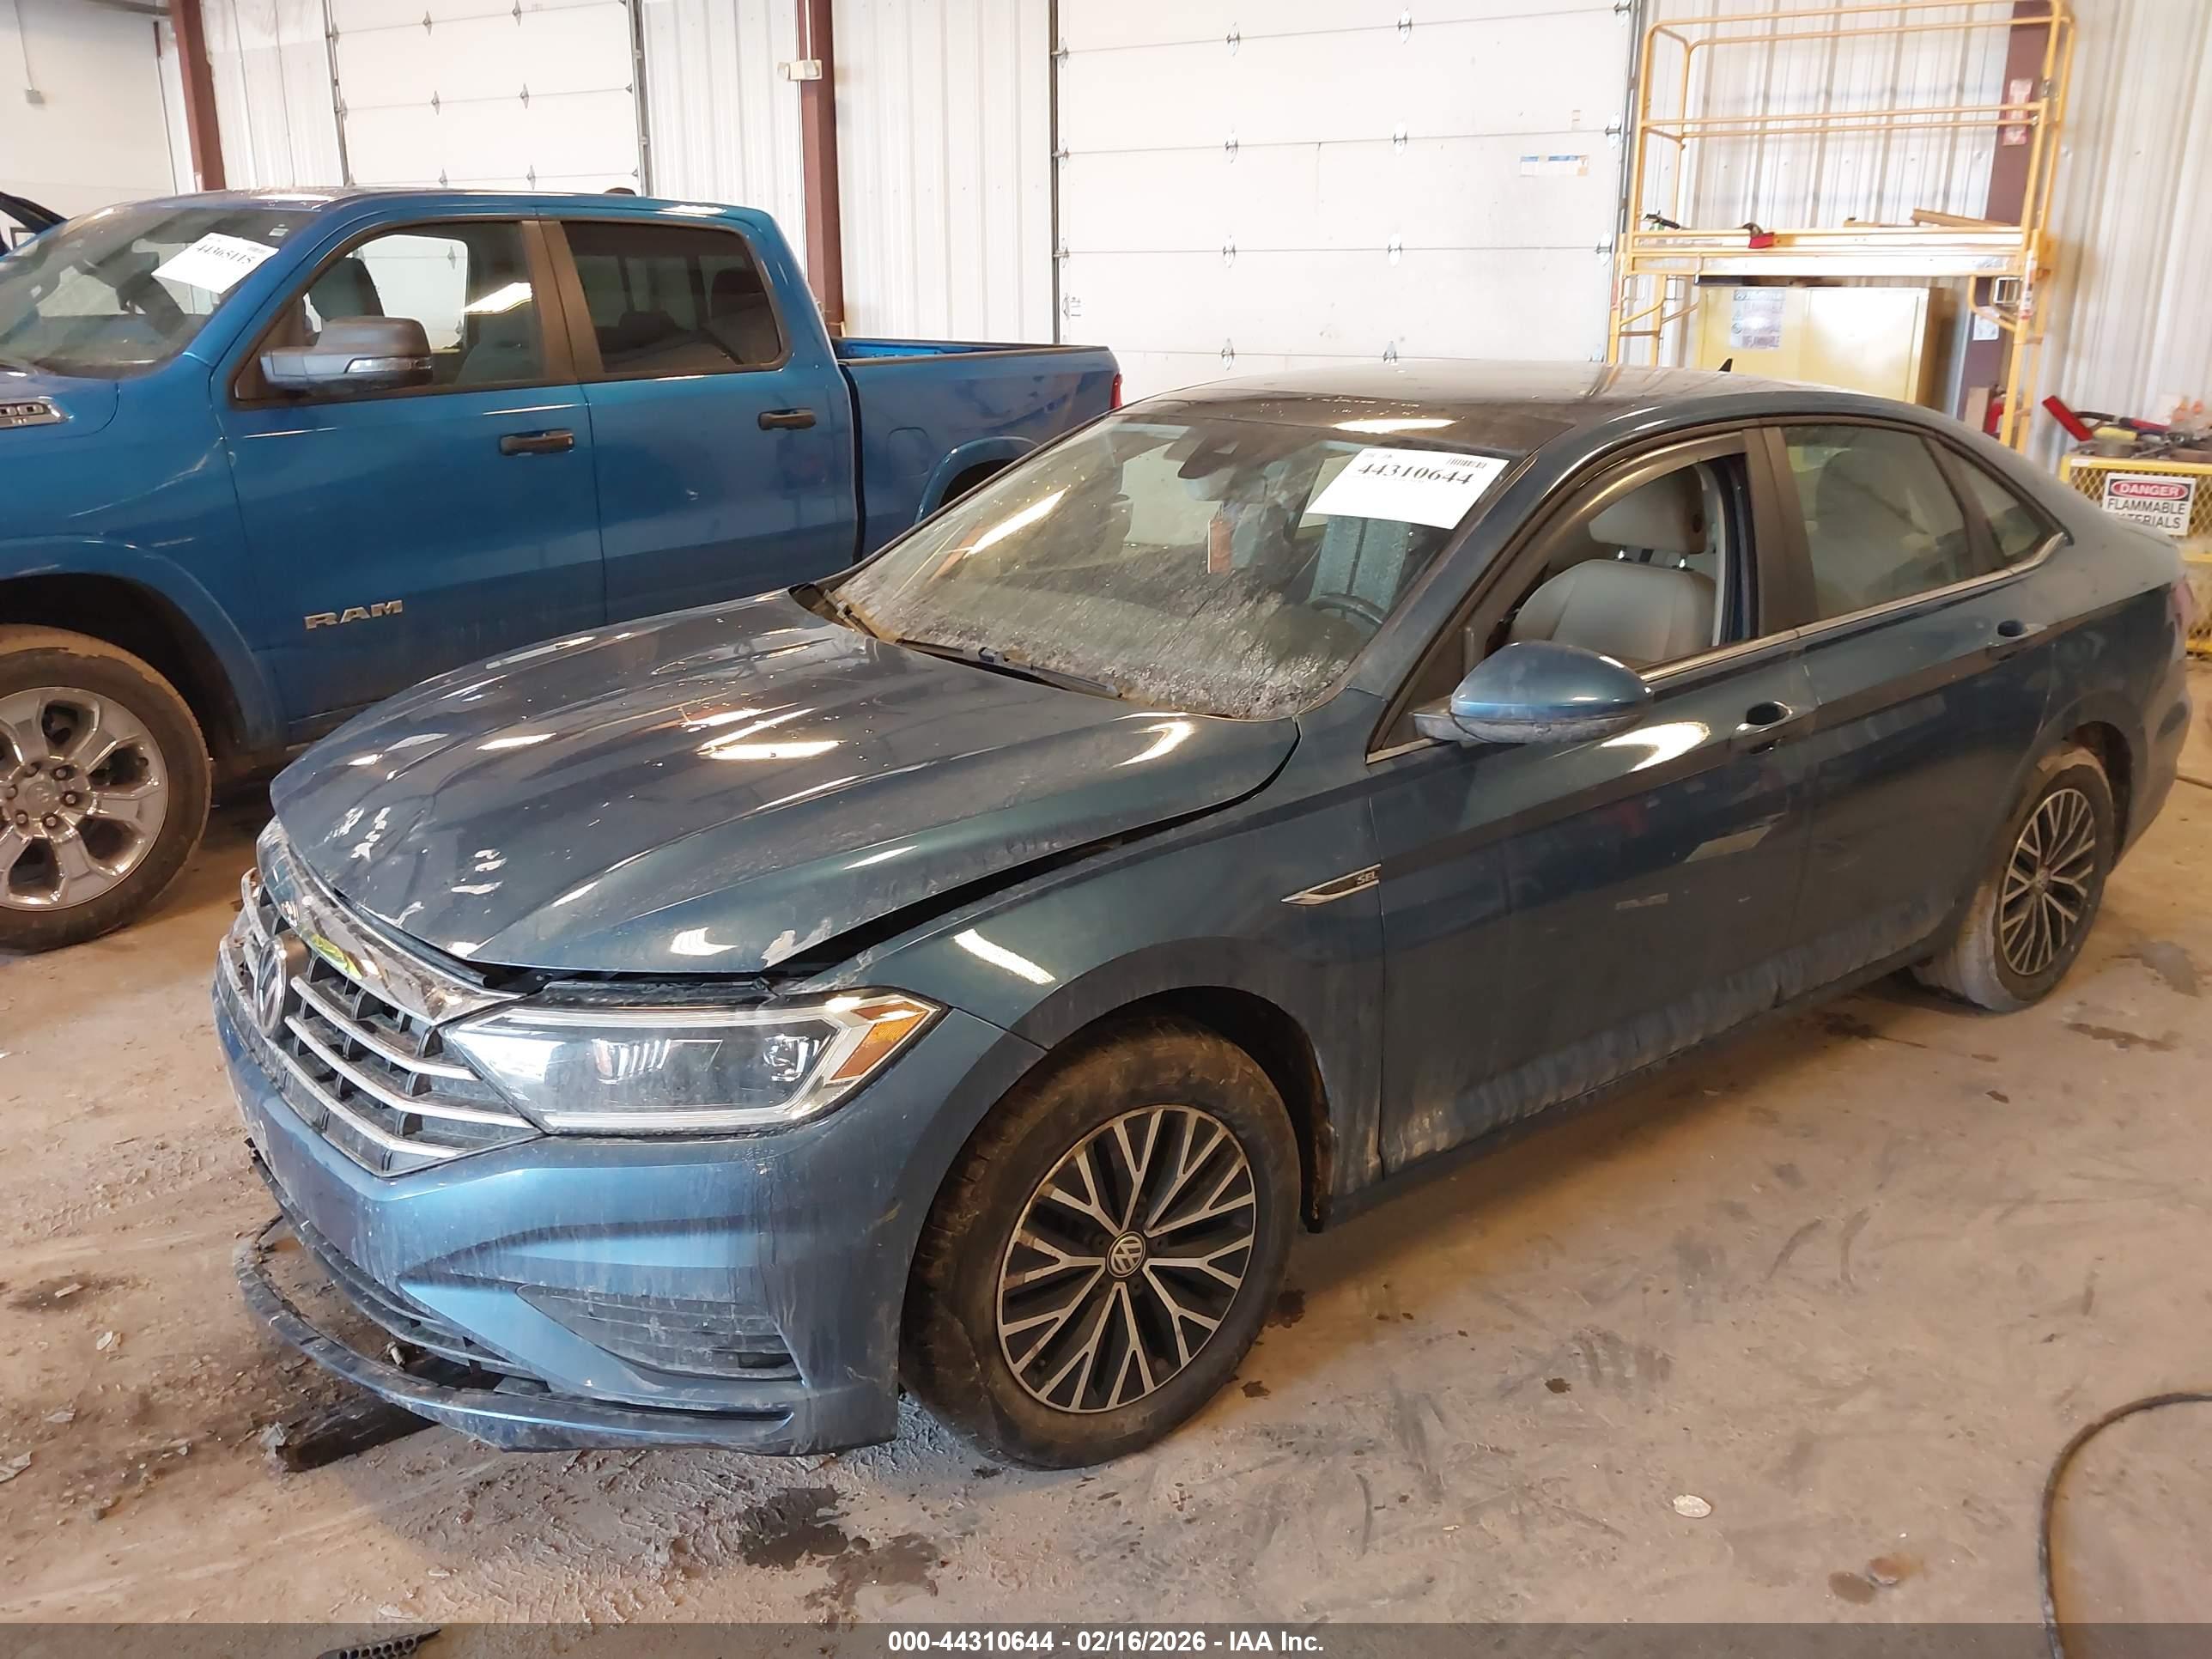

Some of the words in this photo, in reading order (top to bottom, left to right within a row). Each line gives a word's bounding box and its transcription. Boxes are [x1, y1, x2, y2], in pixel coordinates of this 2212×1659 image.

[1358, 463, 1474, 485] 44310644
[2119, 483, 2179, 497] DANGER
[2107, 498, 2186, 515] FLAMMABLE
[2118, 514, 2182, 530] TERIALS
[305, 599, 404, 630] RAM
